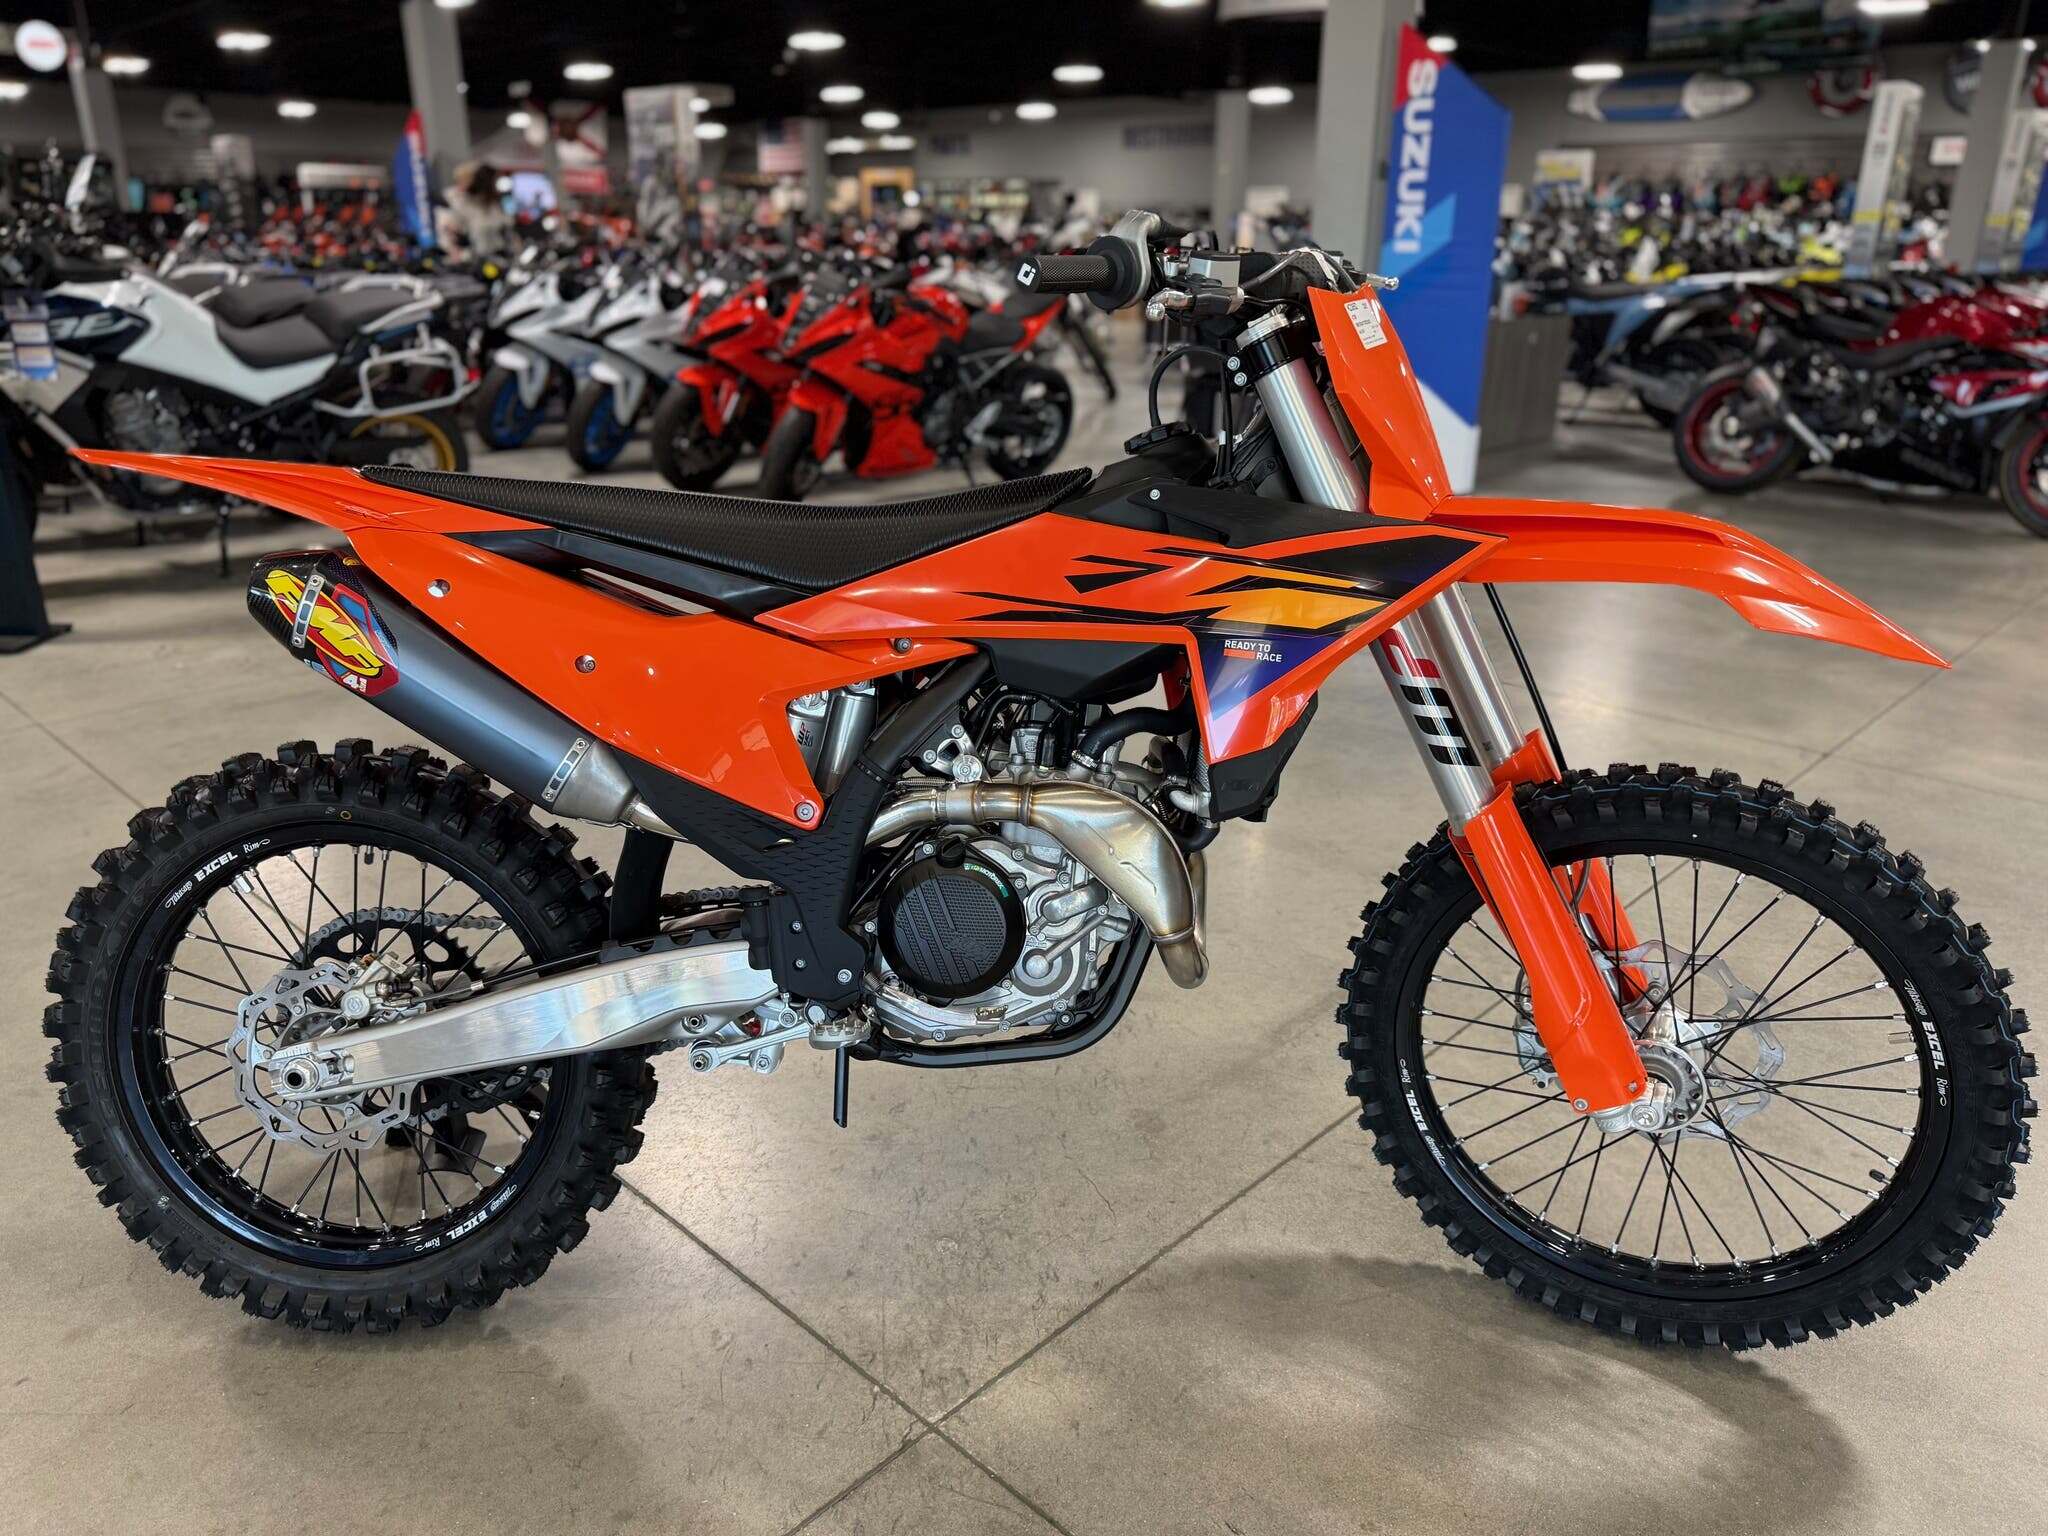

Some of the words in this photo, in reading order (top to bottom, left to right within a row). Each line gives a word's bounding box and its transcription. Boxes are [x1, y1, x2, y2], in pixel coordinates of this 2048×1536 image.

[1393, 58, 1438, 253] SUZUKI
[1224, 640, 1257, 651] READY
[1258, 643, 1272, 652] TO
[1256, 652, 1282, 662] RACE
[194, 851, 239, 883] EXCEL
[1921, 1021, 1946, 1070] EXCEL
[1405, 1089, 1429, 1132] EXCEL
[446, 1209, 489, 1240] EXCEL
